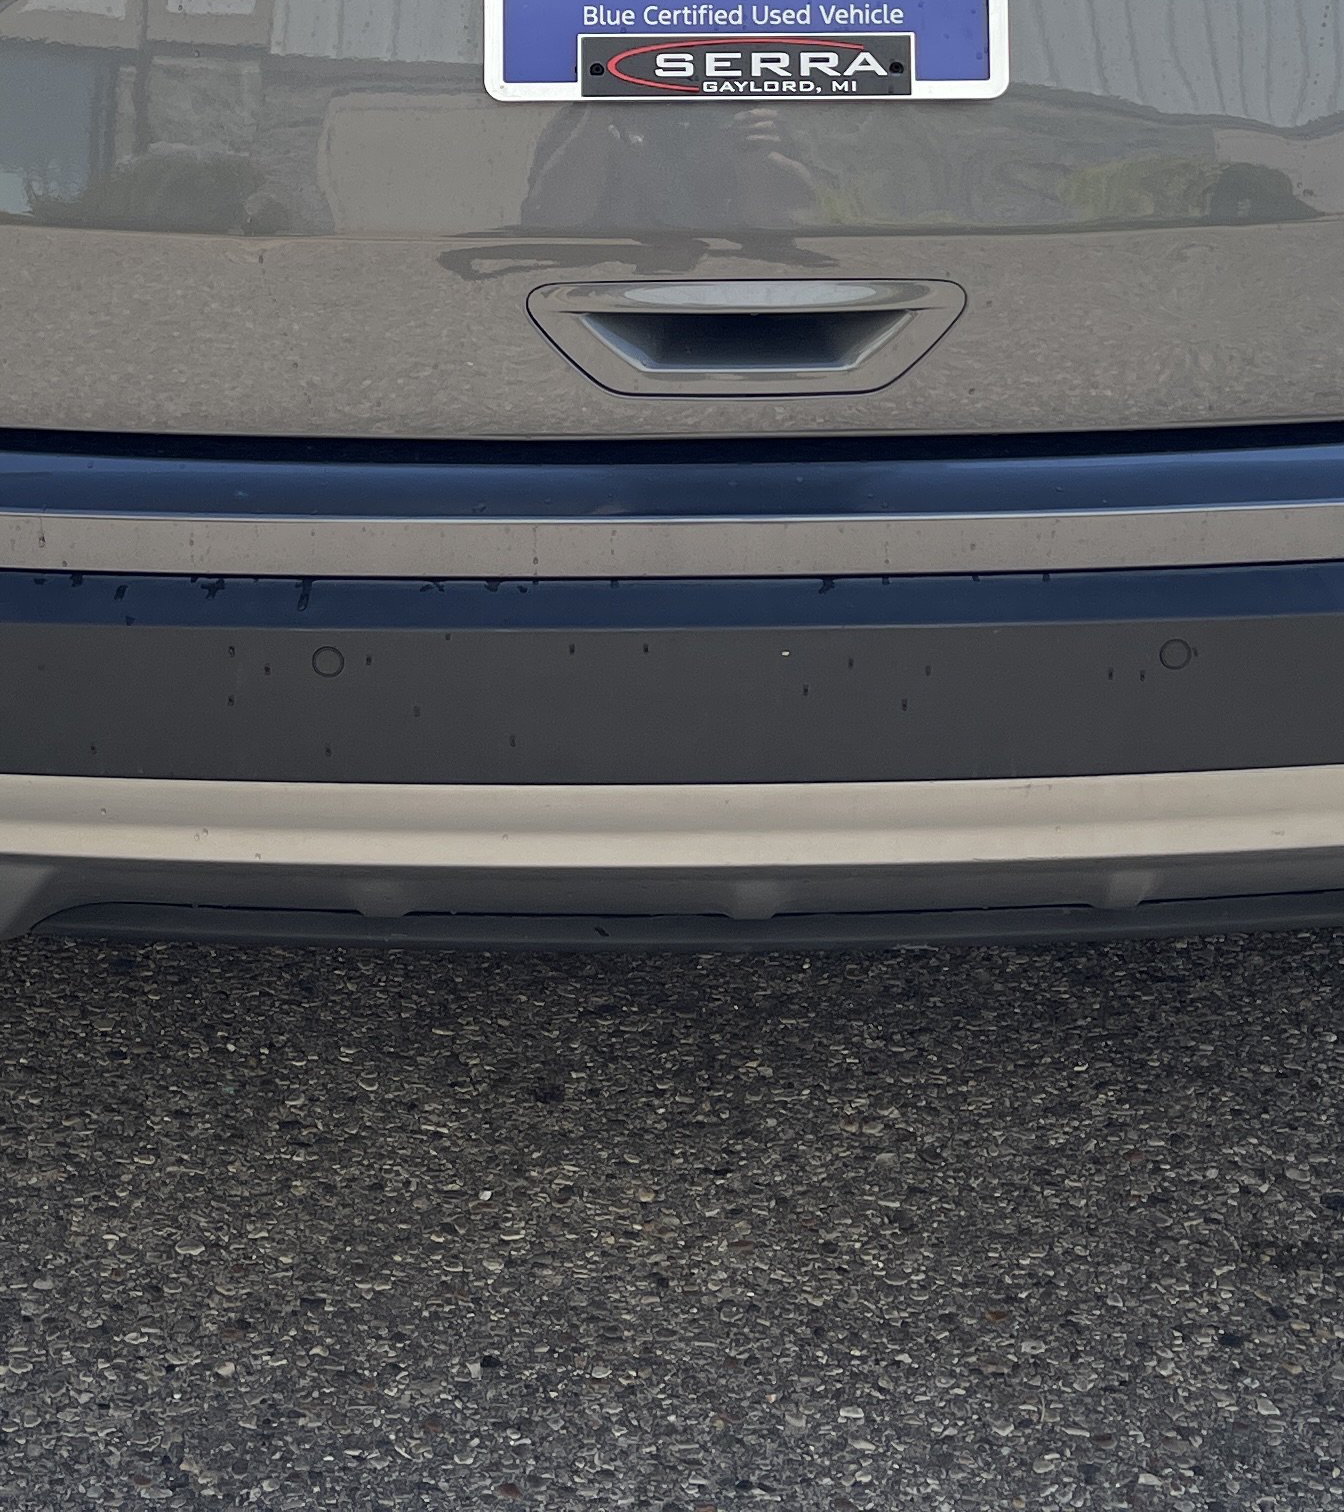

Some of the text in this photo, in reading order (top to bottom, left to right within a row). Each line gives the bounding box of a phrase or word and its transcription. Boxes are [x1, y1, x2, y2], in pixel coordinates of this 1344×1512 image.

[583, 3, 905, 26] Blue Certified Used Vehicle
[654, 51, 888, 78] SERRA
[702, 80, 857, 95] GAYLORD, MI
